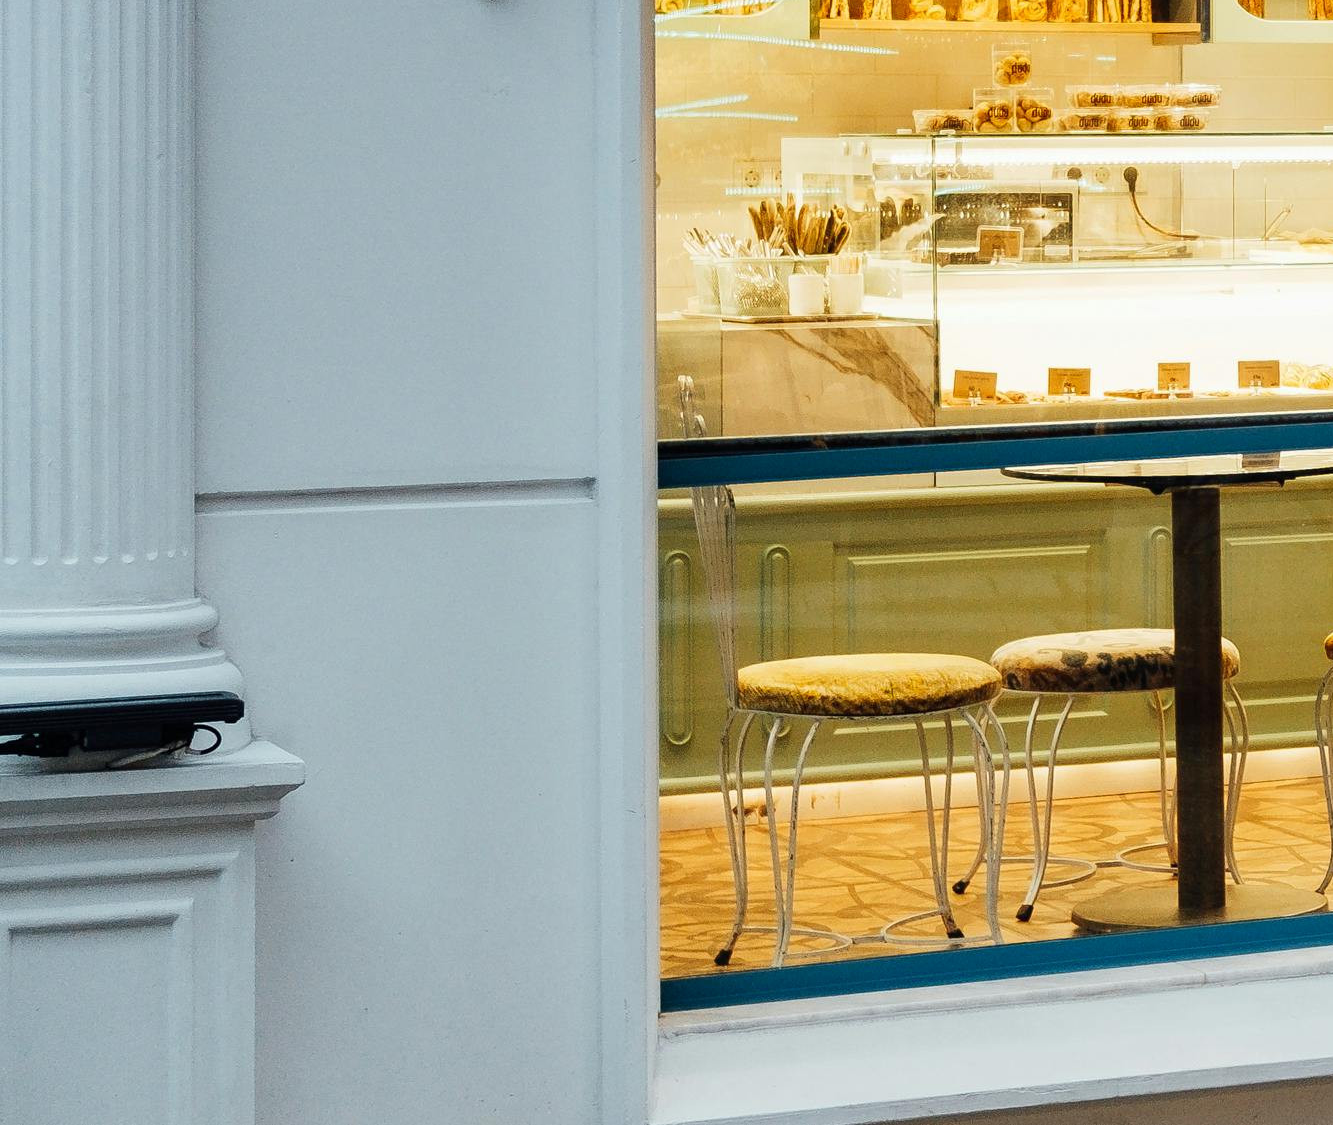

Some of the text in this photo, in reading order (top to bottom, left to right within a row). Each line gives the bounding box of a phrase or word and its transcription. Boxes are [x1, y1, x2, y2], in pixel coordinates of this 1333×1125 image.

[1090, 92, 1112, 104] dudu
[1142, 92, 1163, 104] dudu
[1192, 93, 1212, 104] dudu
[1078, 116, 1099, 127] dudu
[1128, 115, 1149, 127] dudu
[1180, 115, 1200, 127] dudu
